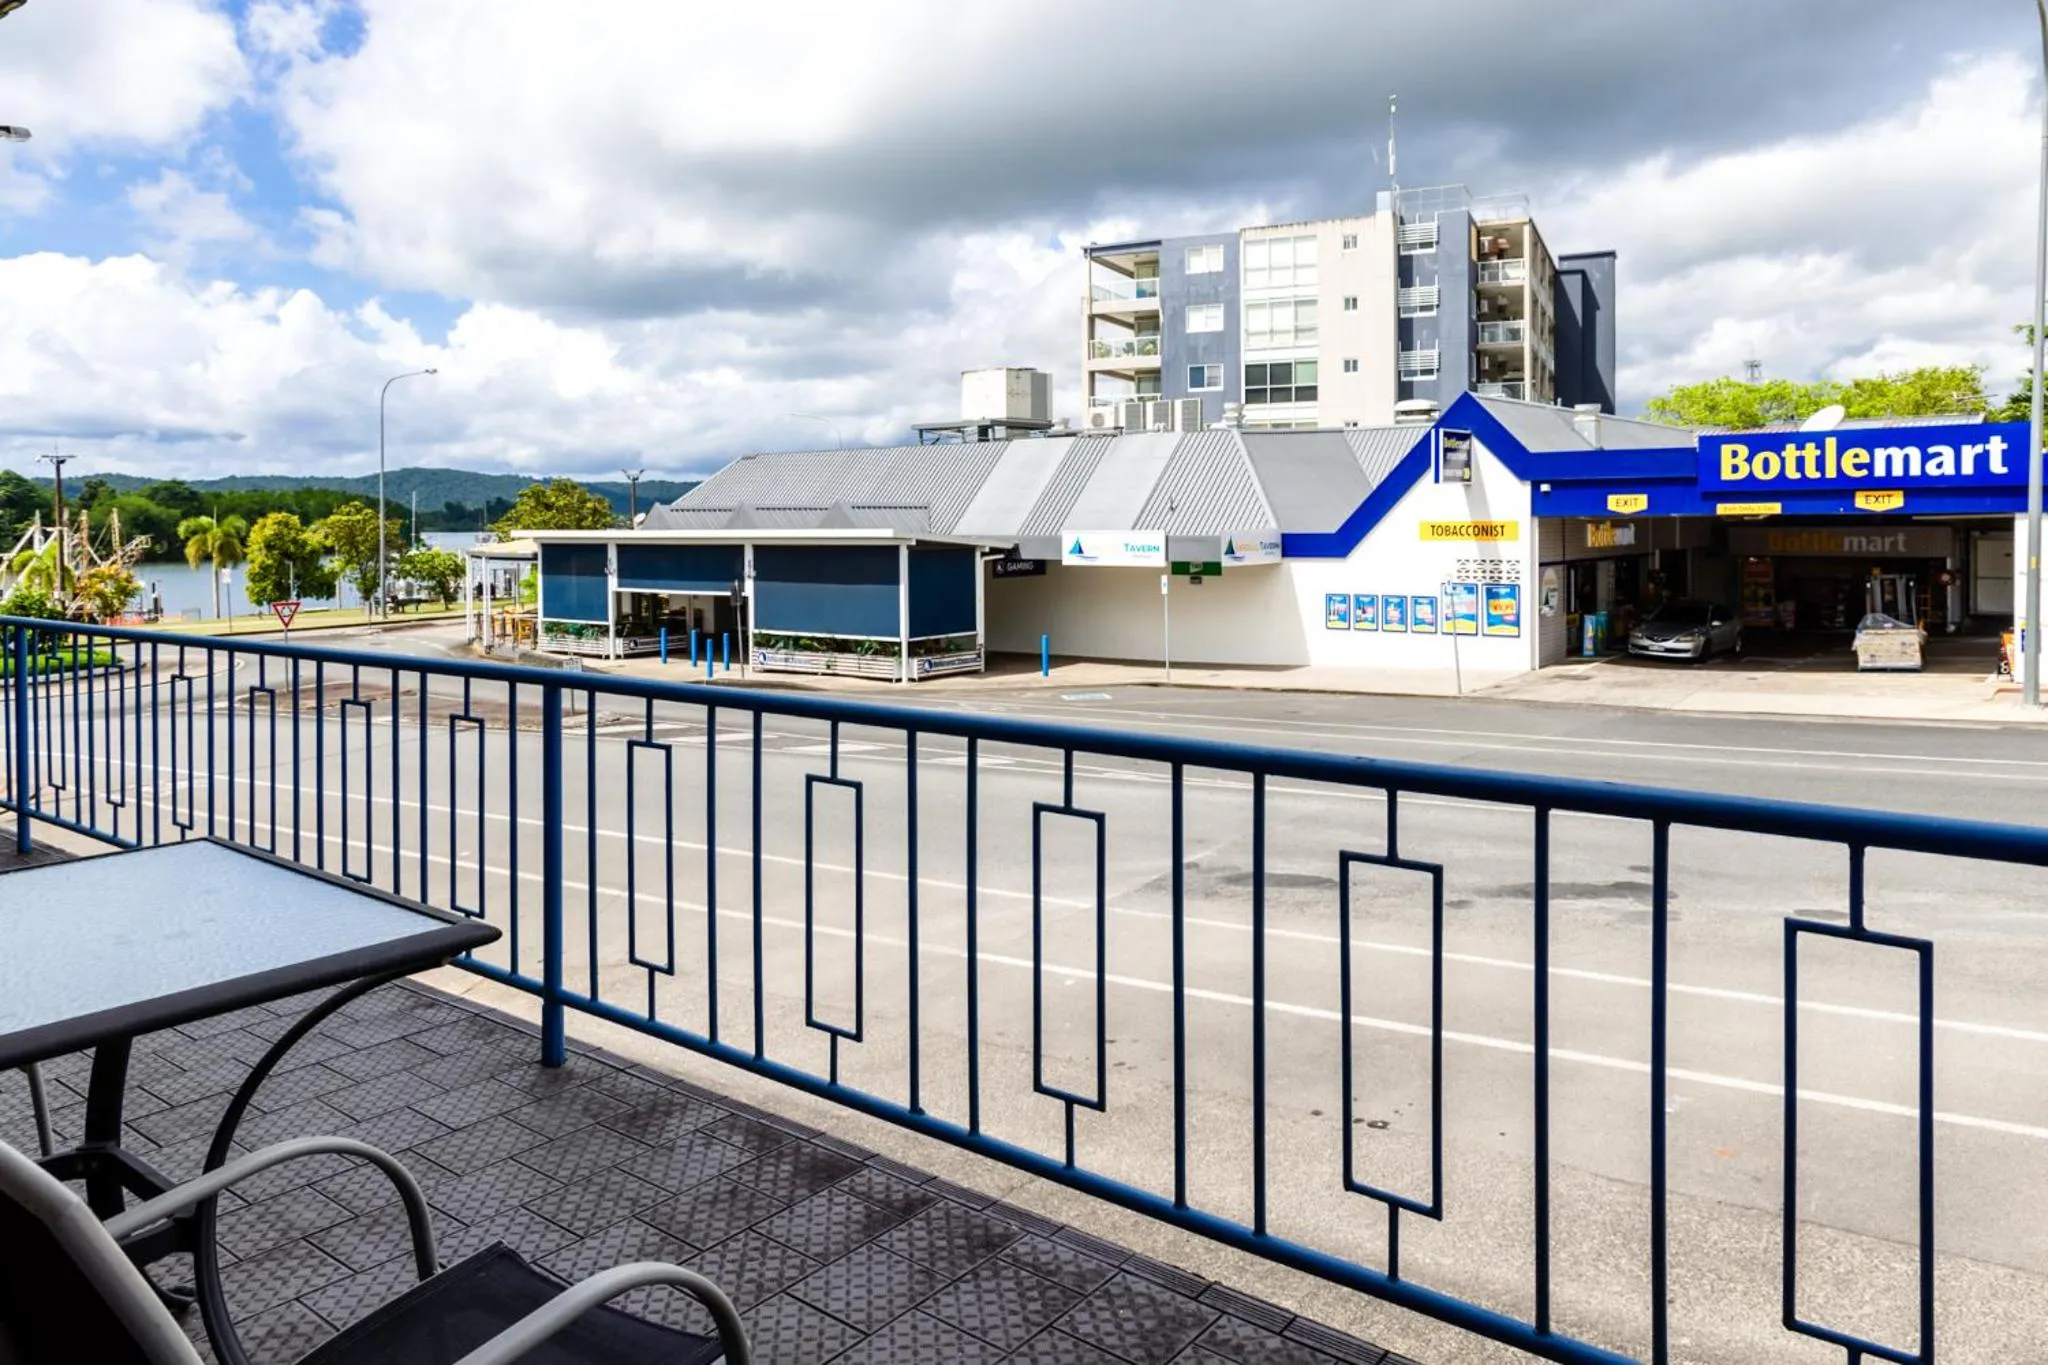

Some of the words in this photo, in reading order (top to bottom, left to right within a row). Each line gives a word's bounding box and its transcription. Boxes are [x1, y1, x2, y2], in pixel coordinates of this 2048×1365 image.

[1719, 436, 2009, 481] Bottlemart
[1615, 497, 1638, 508] EXIT
[1864, 494, 1893, 505] EXIT
[1430, 524, 1506, 537] TOBACCONIST
